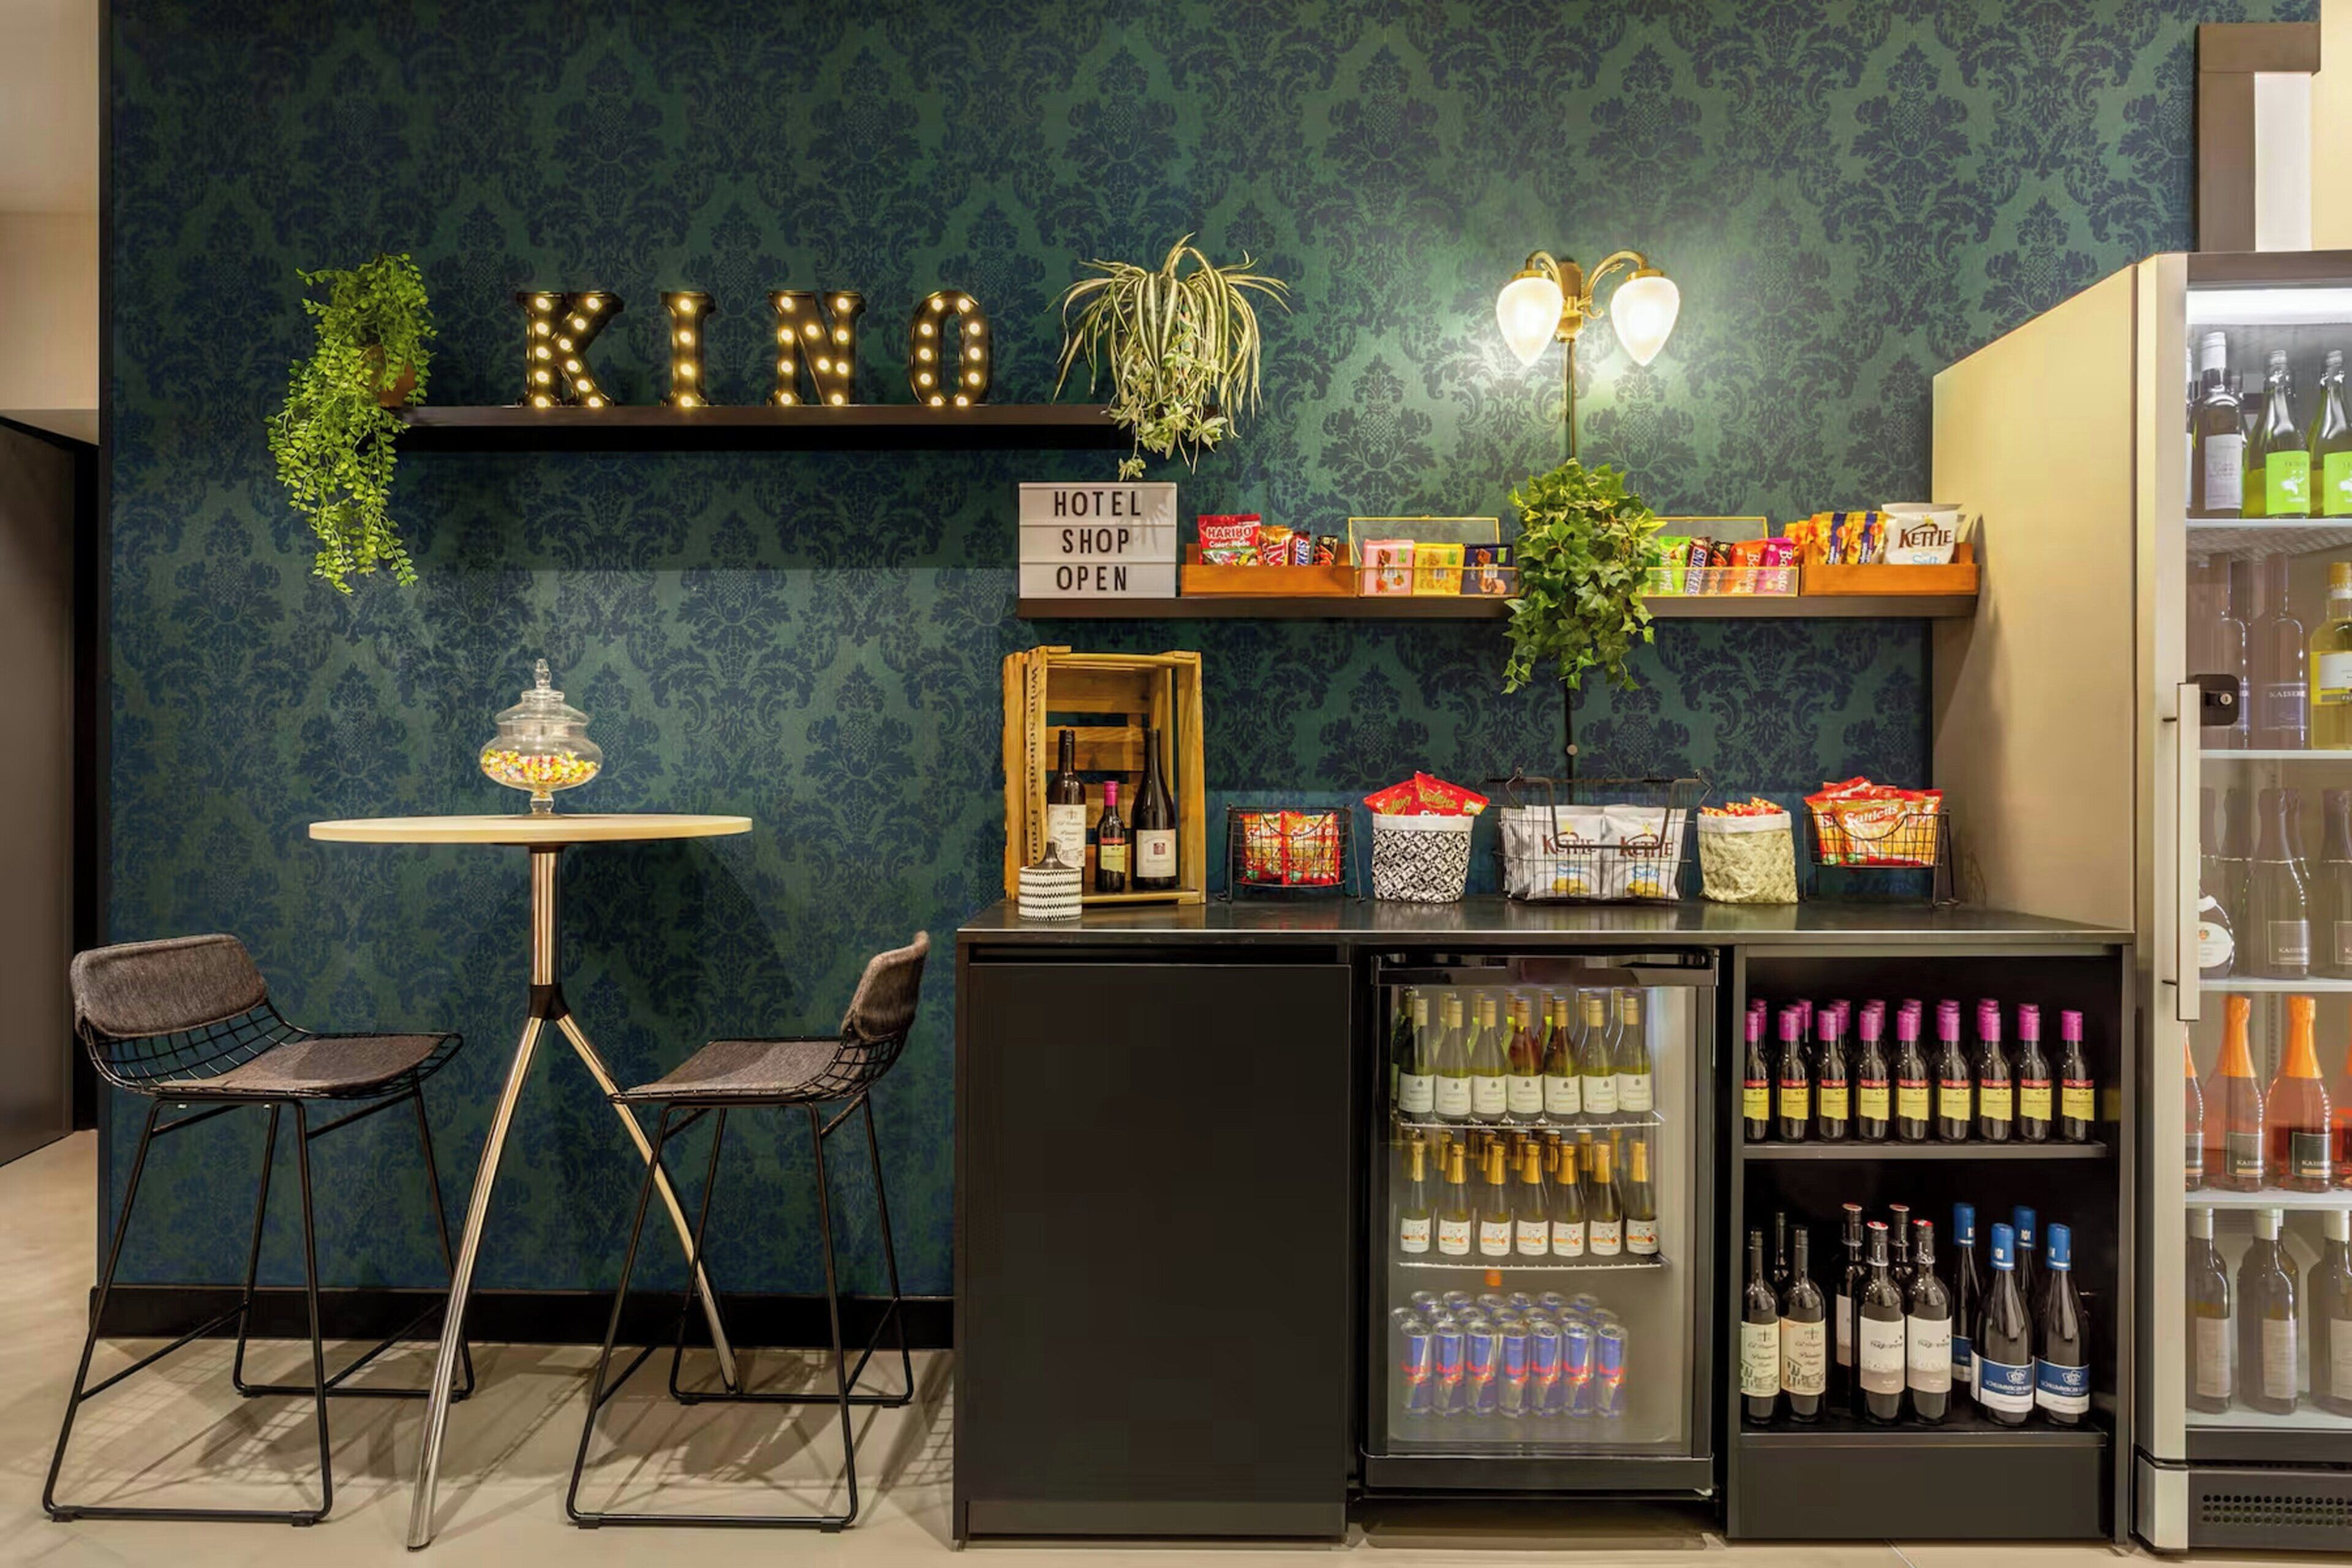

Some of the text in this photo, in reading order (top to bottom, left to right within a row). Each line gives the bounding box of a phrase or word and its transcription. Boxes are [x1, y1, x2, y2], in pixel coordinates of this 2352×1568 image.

[516, 290, 993, 407] KINO
[1054, 491, 1141, 516] HOTEL
[1062, 529, 1129, 554] SHOP
[1207, 526, 1253, 539] HARIBO
[1898, 523, 1953, 548] KETTLE
[1057, 566, 1127, 591] OPEN
[1686, 548, 1706, 595] SNICKERS
